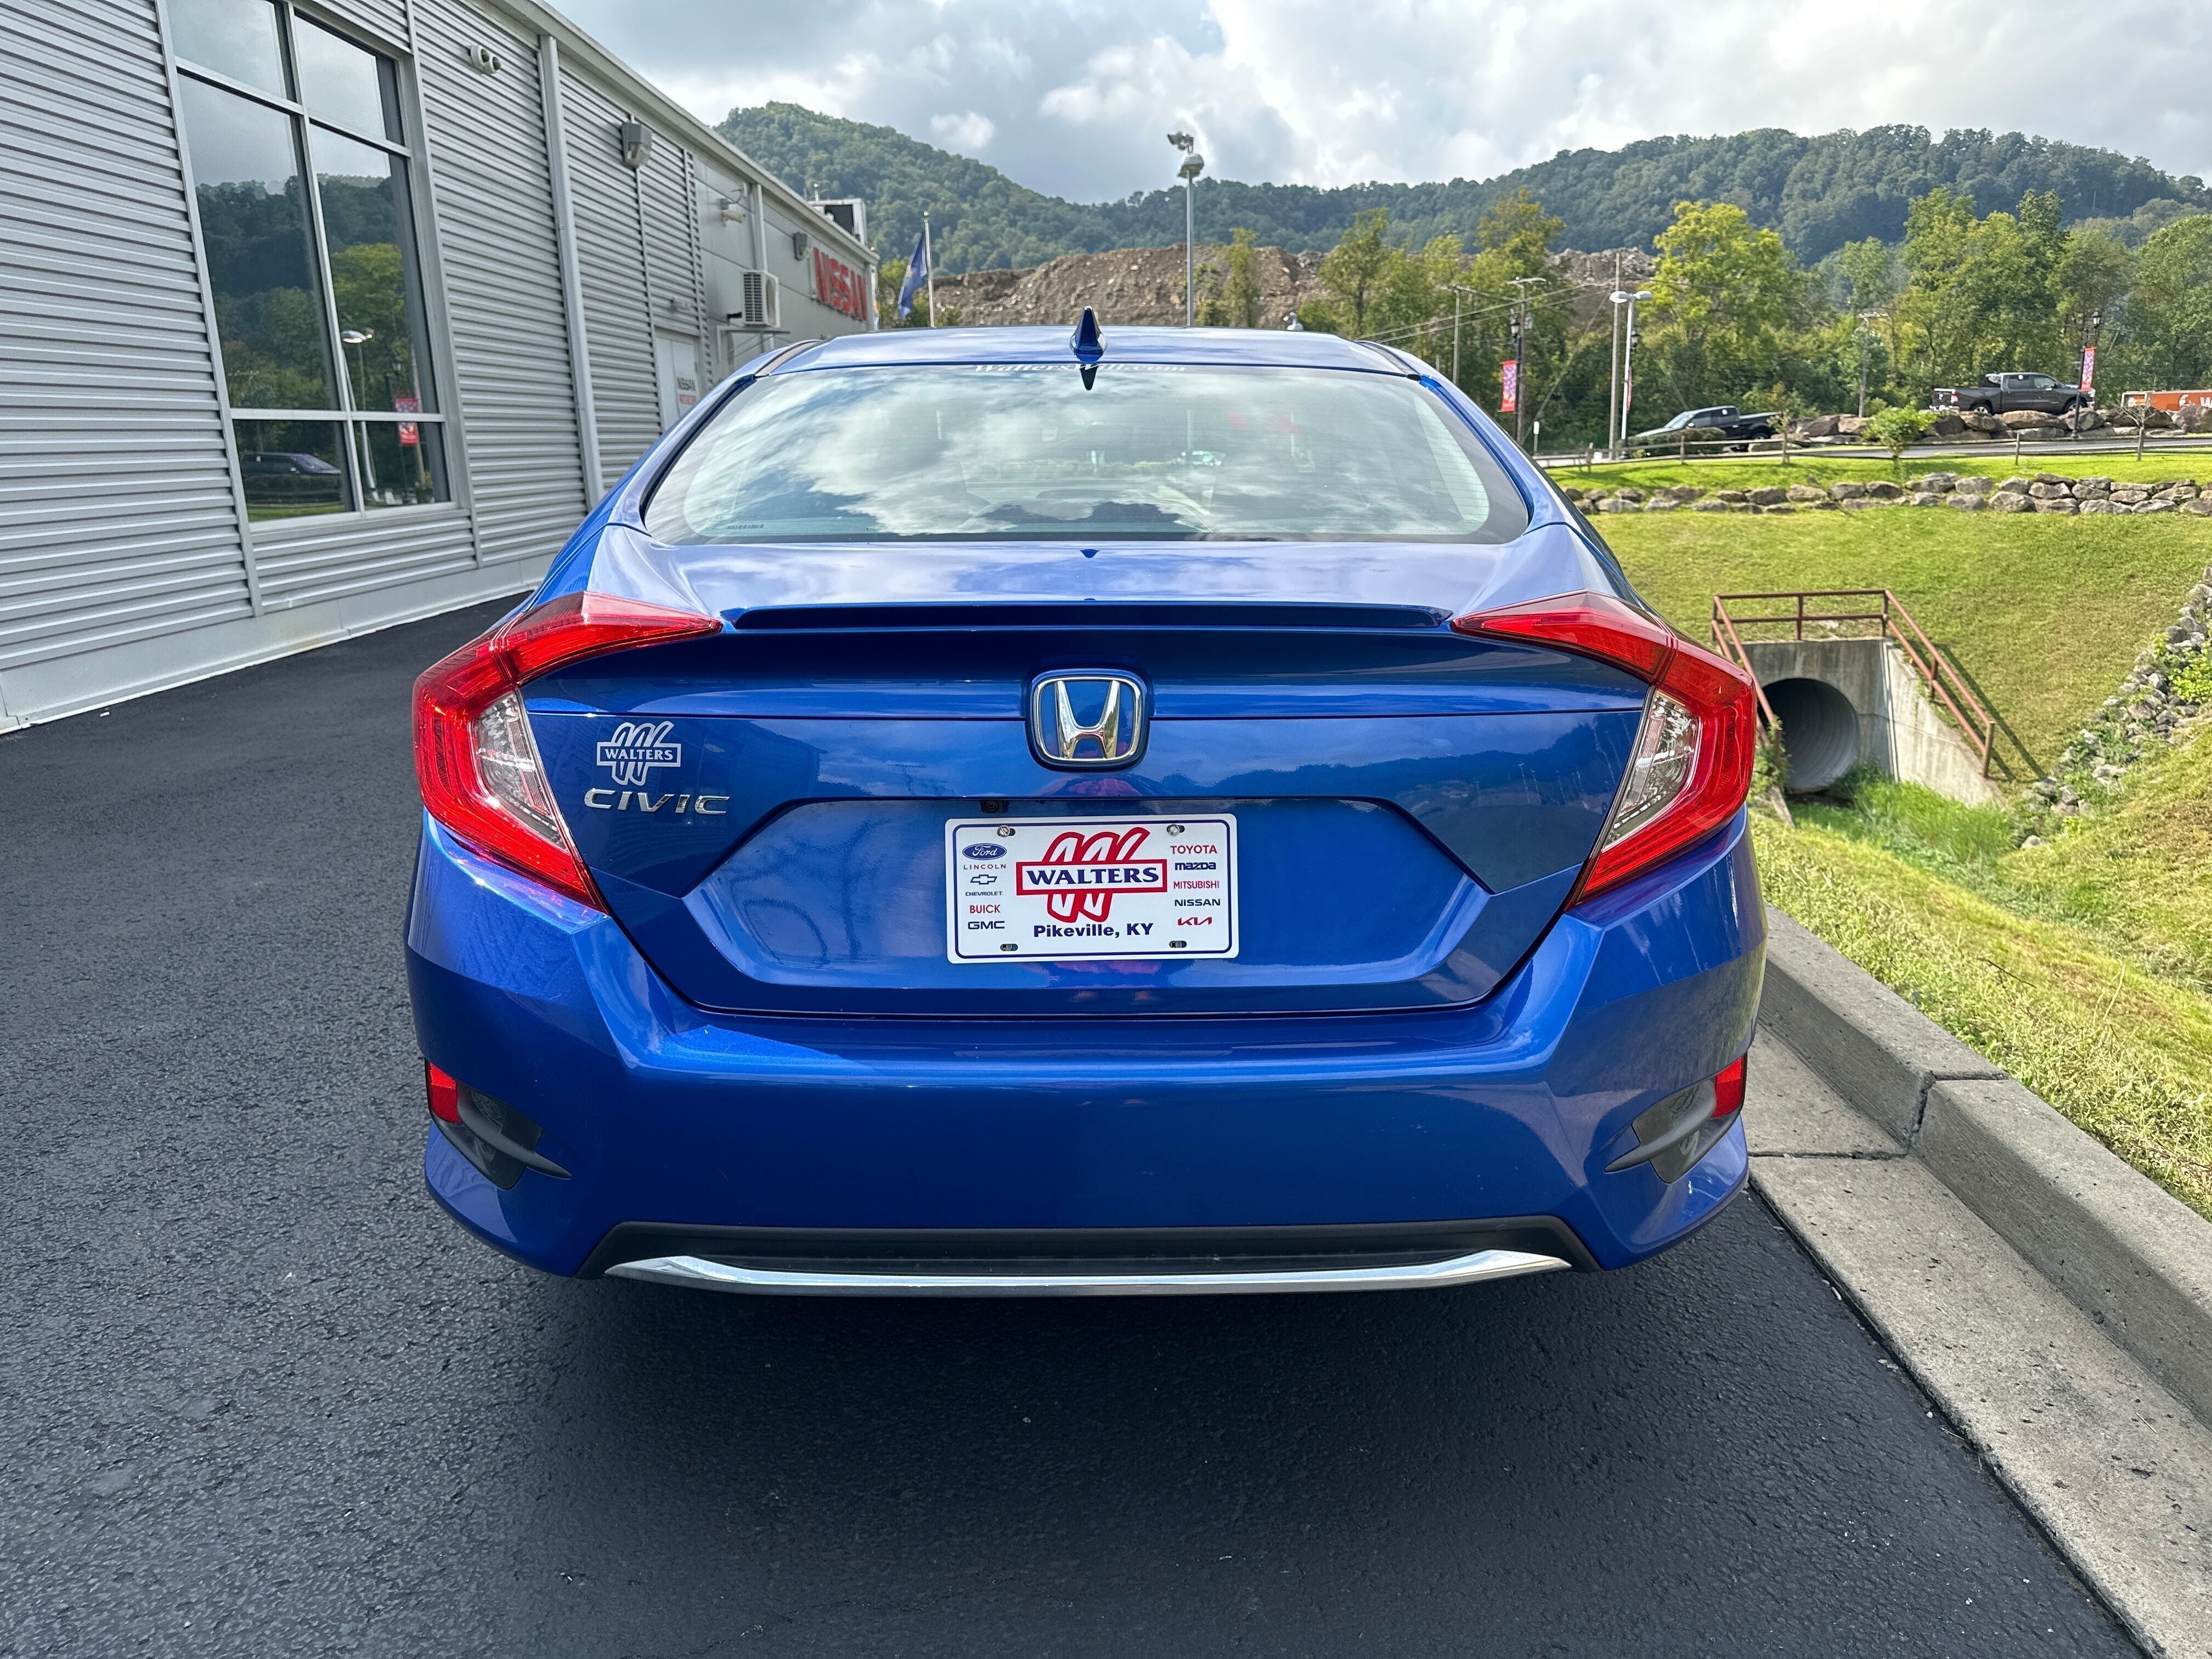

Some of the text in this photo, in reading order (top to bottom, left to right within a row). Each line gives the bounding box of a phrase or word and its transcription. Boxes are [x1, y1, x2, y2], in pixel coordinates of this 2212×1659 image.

[814, 247, 869, 321] NISSAN
[605, 749, 673, 760] WALTERS
[584, 788, 730, 814] CIVIC
[972, 845, 998, 856] Ford
[1170, 845, 1217, 854] TOYOTA
[1026, 867, 1159, 885] WALTERS
[1173, 880, 1220, 889] MITSUBISHI
[969, 904, 1001, 913] BUICK
[968, 921, 1005, 930] GMC
[1177, 917, 1212, 926] KIA
[1034, 923, 1154, 938] Pikeville, KY
